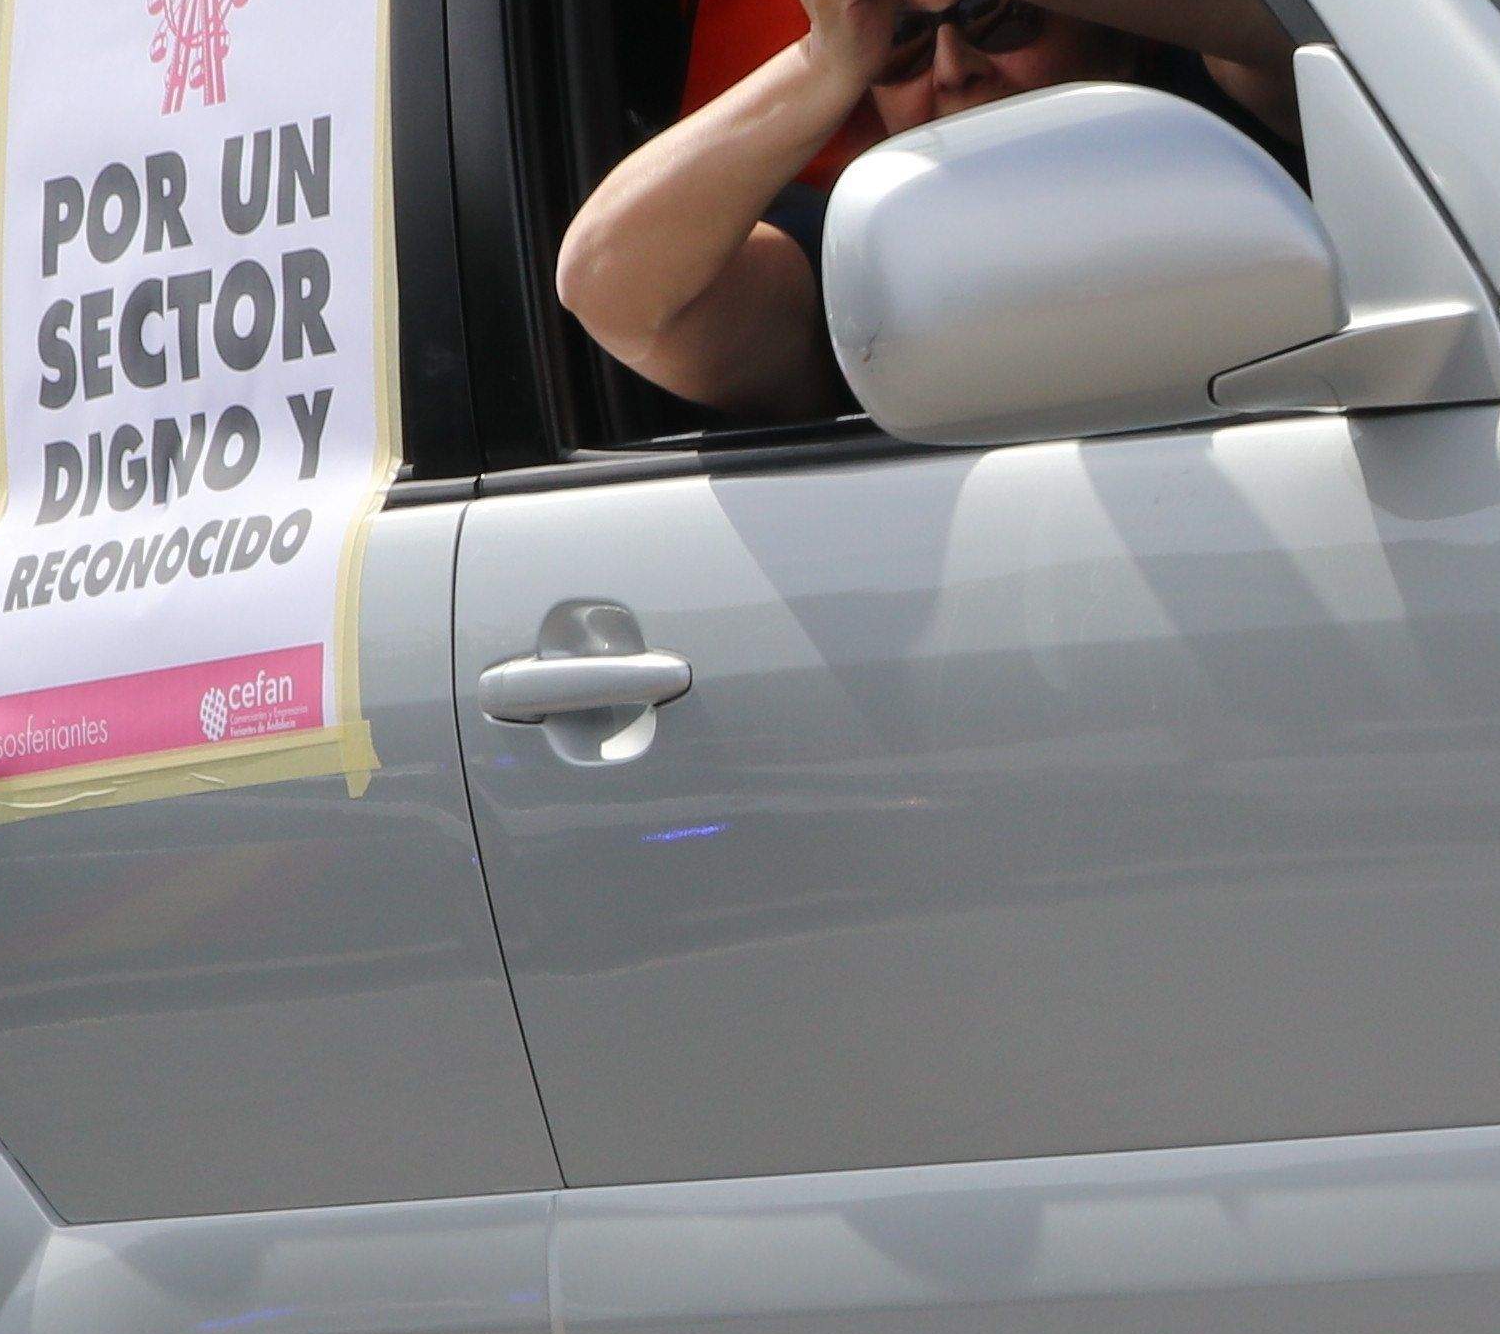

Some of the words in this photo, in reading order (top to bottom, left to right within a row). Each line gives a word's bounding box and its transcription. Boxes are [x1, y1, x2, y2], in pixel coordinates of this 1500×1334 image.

[41, 150, 193, 279] POR
[220, 113, 333, 236] UN
[36, 247, 338, 411] SECTOR
[34, 403, 262, 527] DIGNO
[286, 387, 335, 481] Y
[1, 507, 314, 614] RECONOCIDO
[227, 669, 294, 712] cefan
